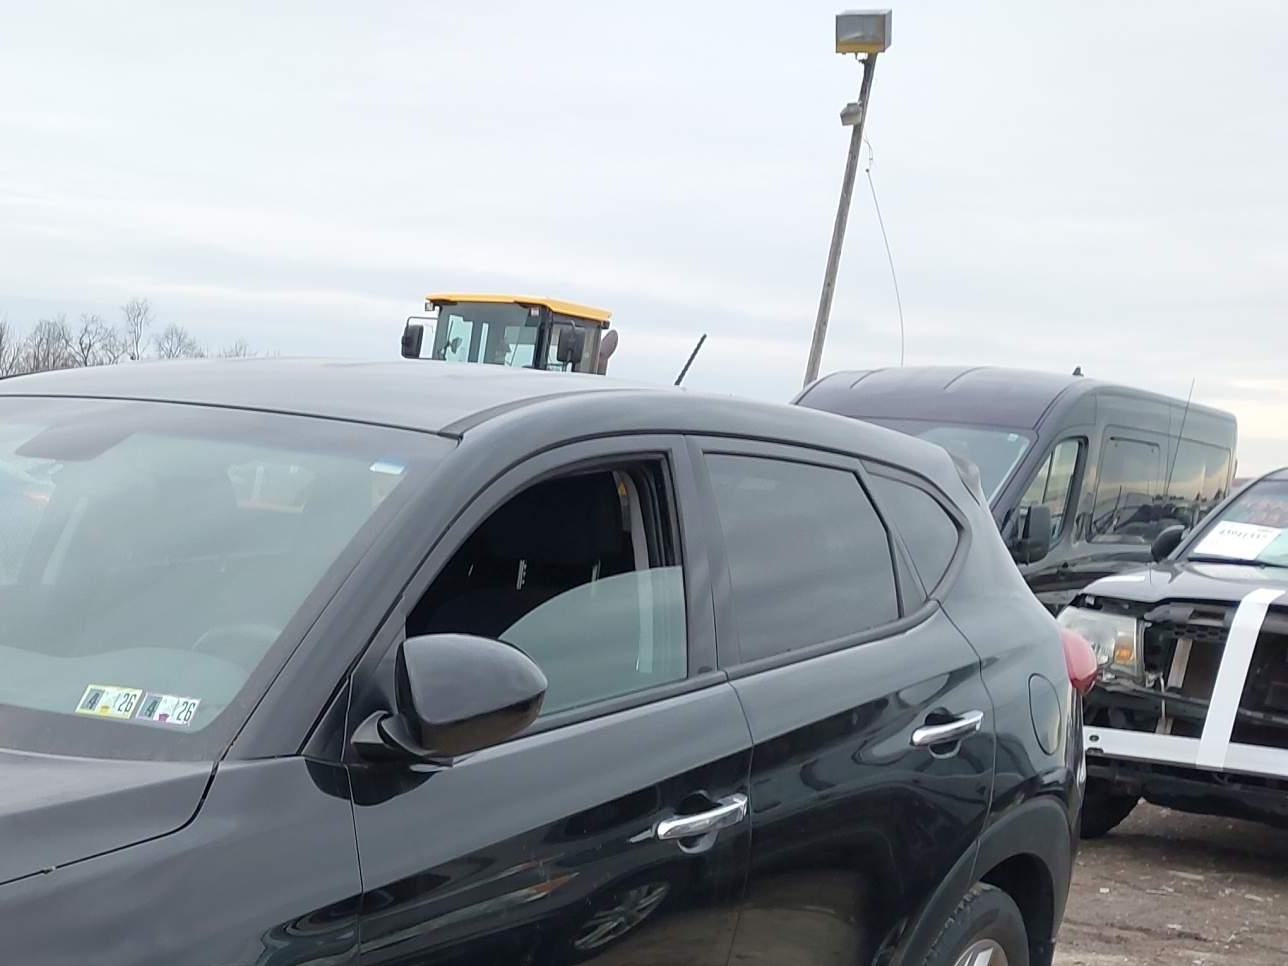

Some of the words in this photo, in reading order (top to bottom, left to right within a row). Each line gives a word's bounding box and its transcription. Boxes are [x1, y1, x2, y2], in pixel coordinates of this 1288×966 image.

[88, 692, 101, 710] 4
[117, 692, 138, 713] 26
[144, 699, 159, 718] 4
[176, 700, 196, 722] 26
